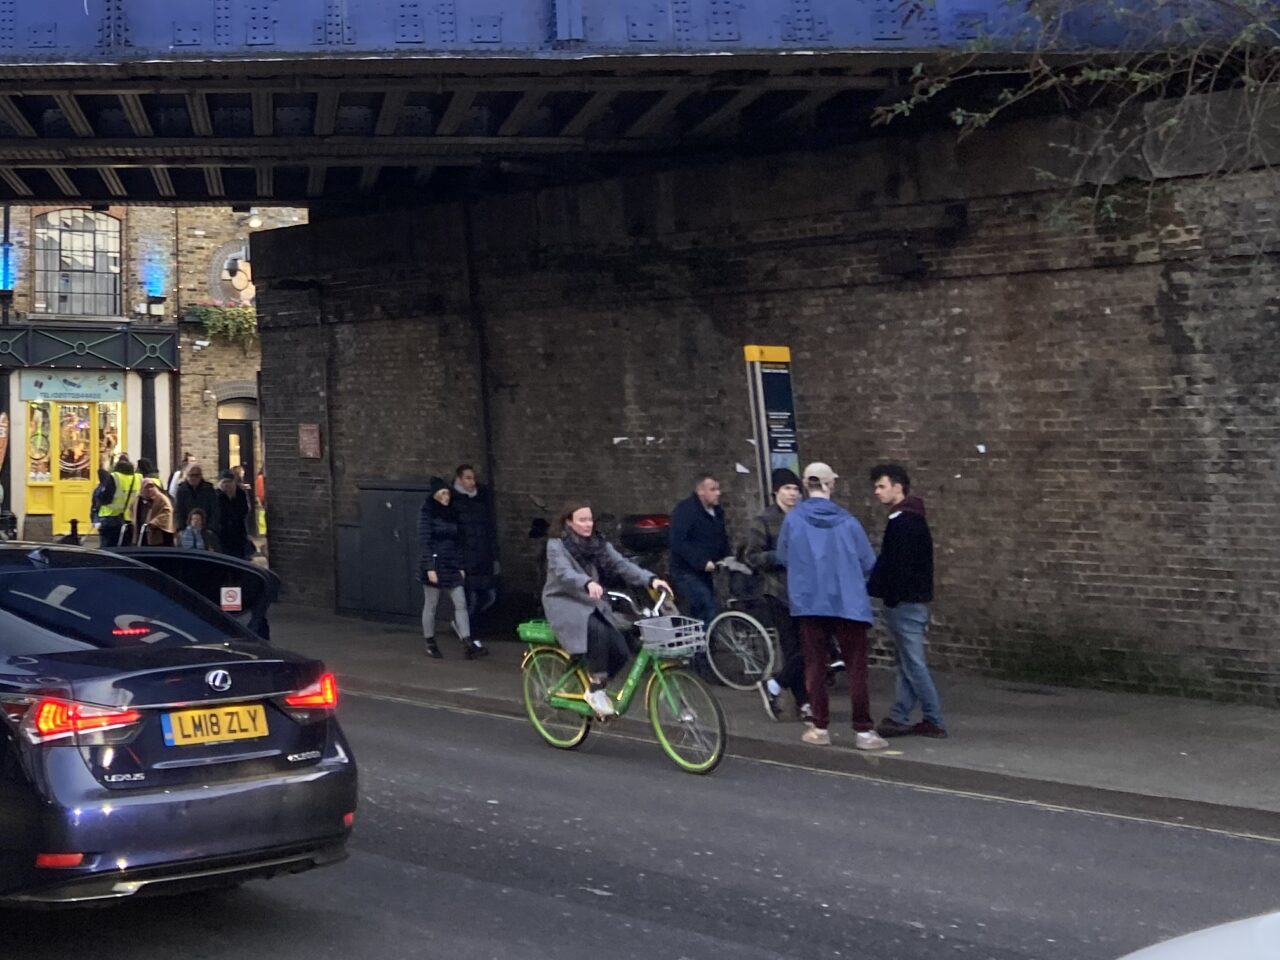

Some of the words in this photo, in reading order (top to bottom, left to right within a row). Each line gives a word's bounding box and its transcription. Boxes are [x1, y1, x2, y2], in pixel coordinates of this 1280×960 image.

[178, 713, 221, 739] LM18
[224, 709, 258, 734] ZLY
[104, 773, 146, 782] LEXUS
